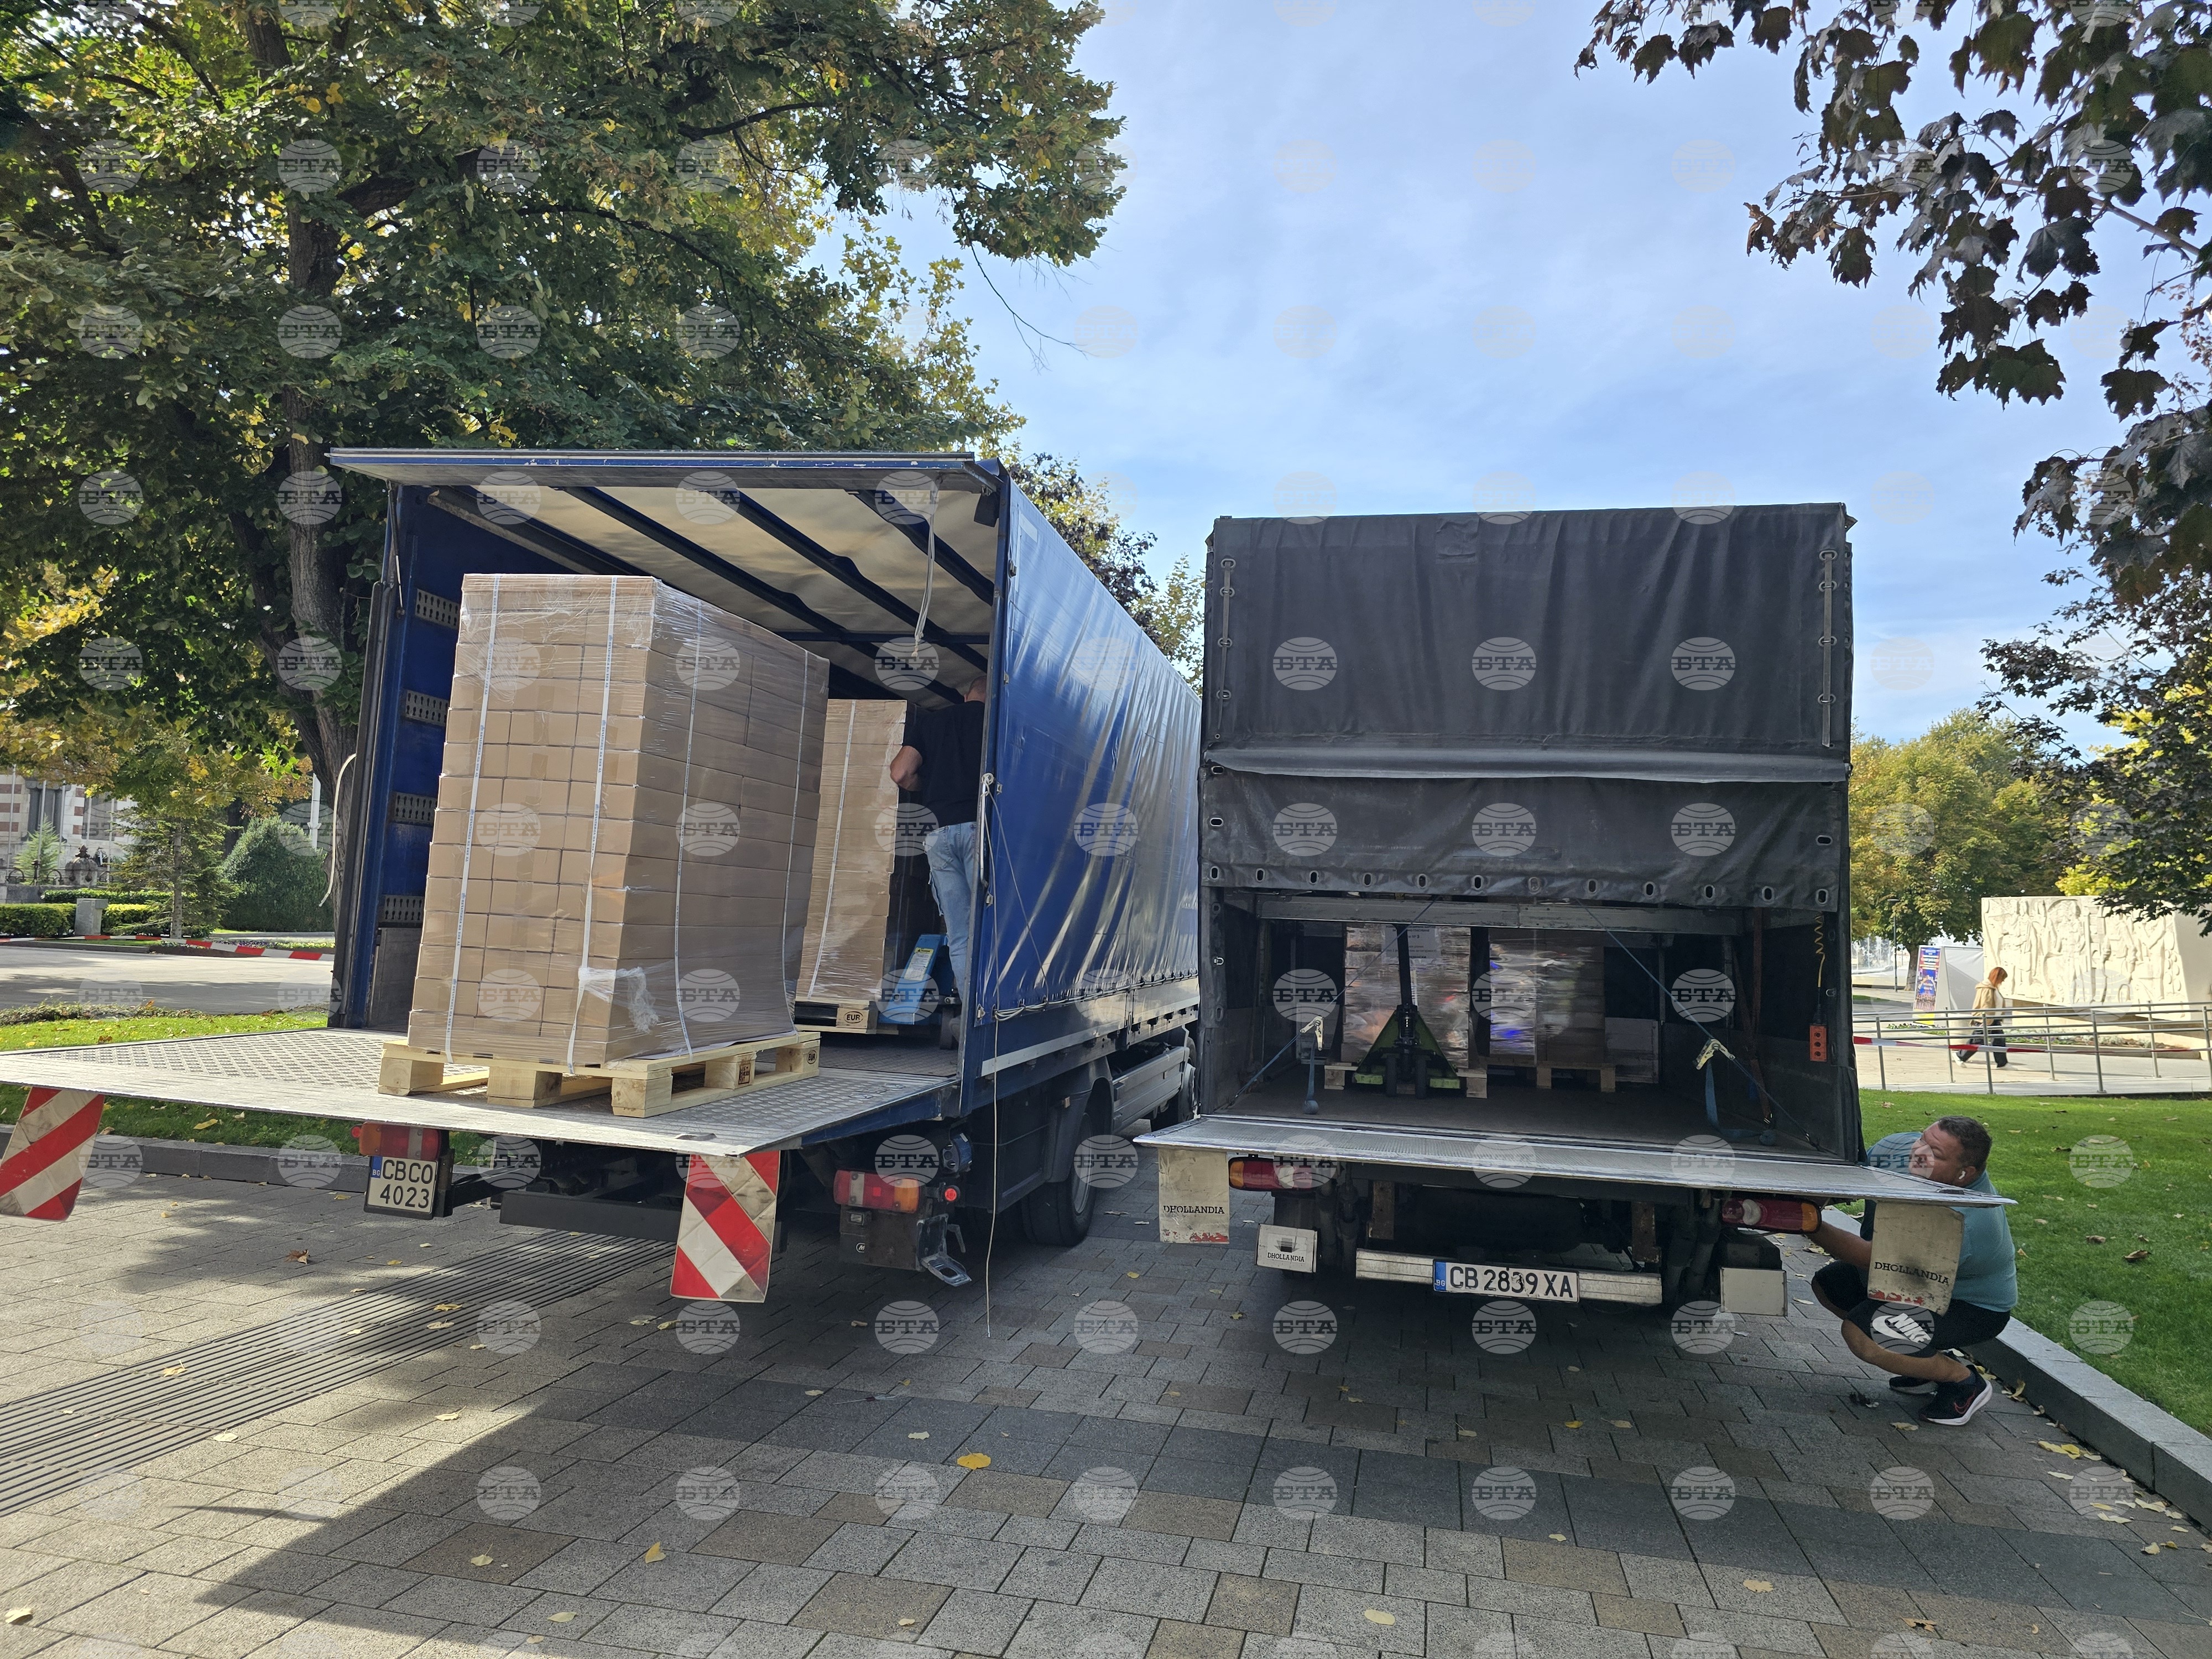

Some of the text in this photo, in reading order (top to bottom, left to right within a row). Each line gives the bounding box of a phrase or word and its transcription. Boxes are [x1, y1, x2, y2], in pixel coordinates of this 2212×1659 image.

[380, 1184, 429, 1209] 4023
[1267, 1252, 1305, 1262] DHOLLANDIA
[1450, 1266, 1573, 1298] CB 2839 XA
[1874, 1261, 1949, 1284] DHOLLANDIA
[1887, 1313, 1932, 1343] NIKE
